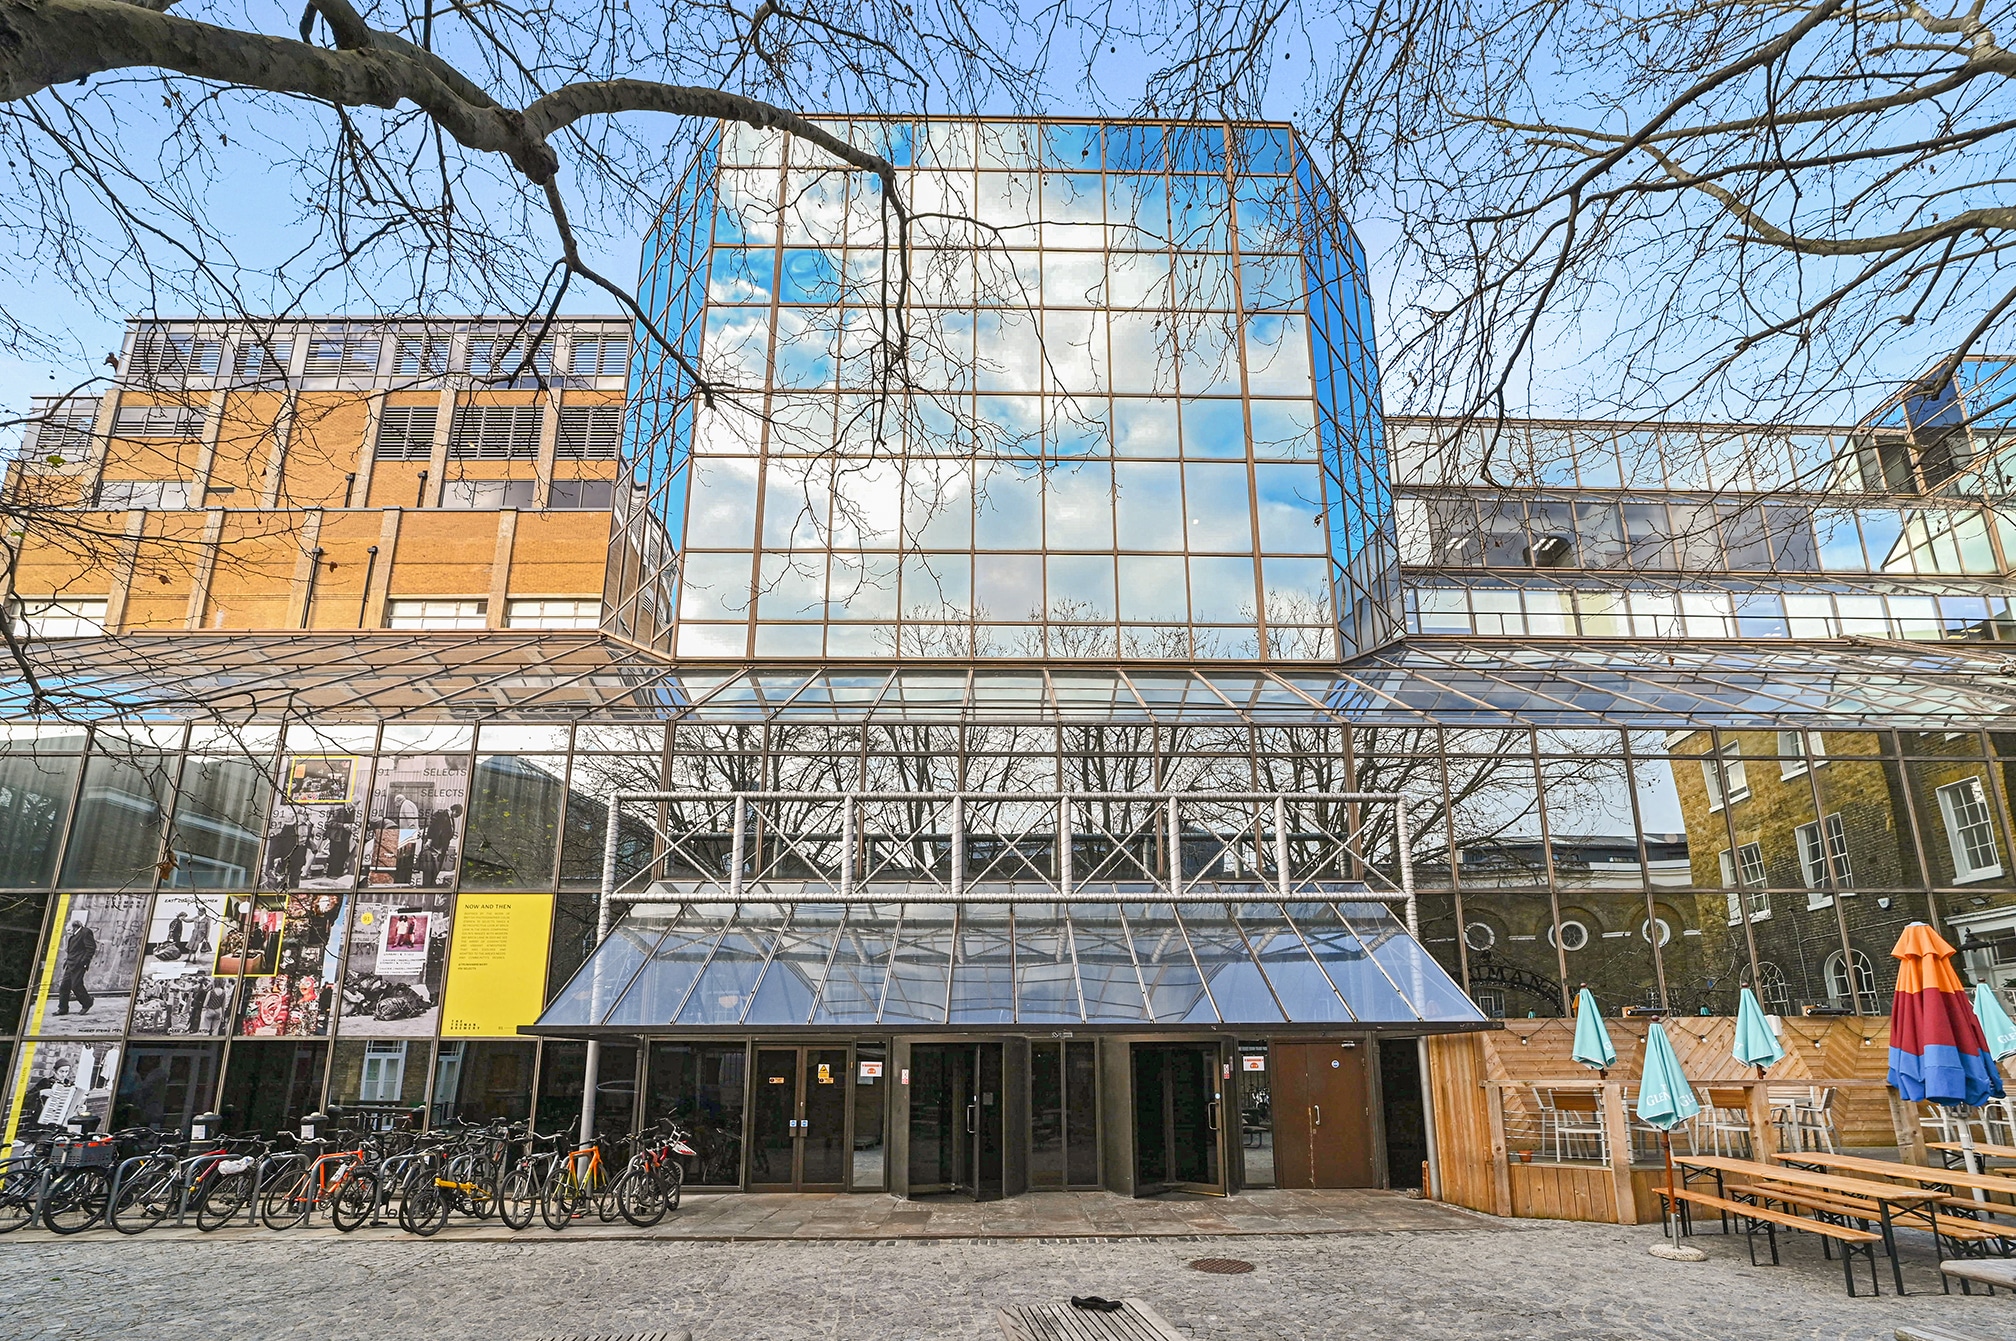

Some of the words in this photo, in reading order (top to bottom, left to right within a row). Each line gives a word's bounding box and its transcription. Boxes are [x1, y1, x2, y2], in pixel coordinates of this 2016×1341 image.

[378, 768, 390, 776] 91
[423, 768, 467, 777] SELECTS
[420, 788, 464, 797] SELECTS
[272, 809, 285, 818] 91
